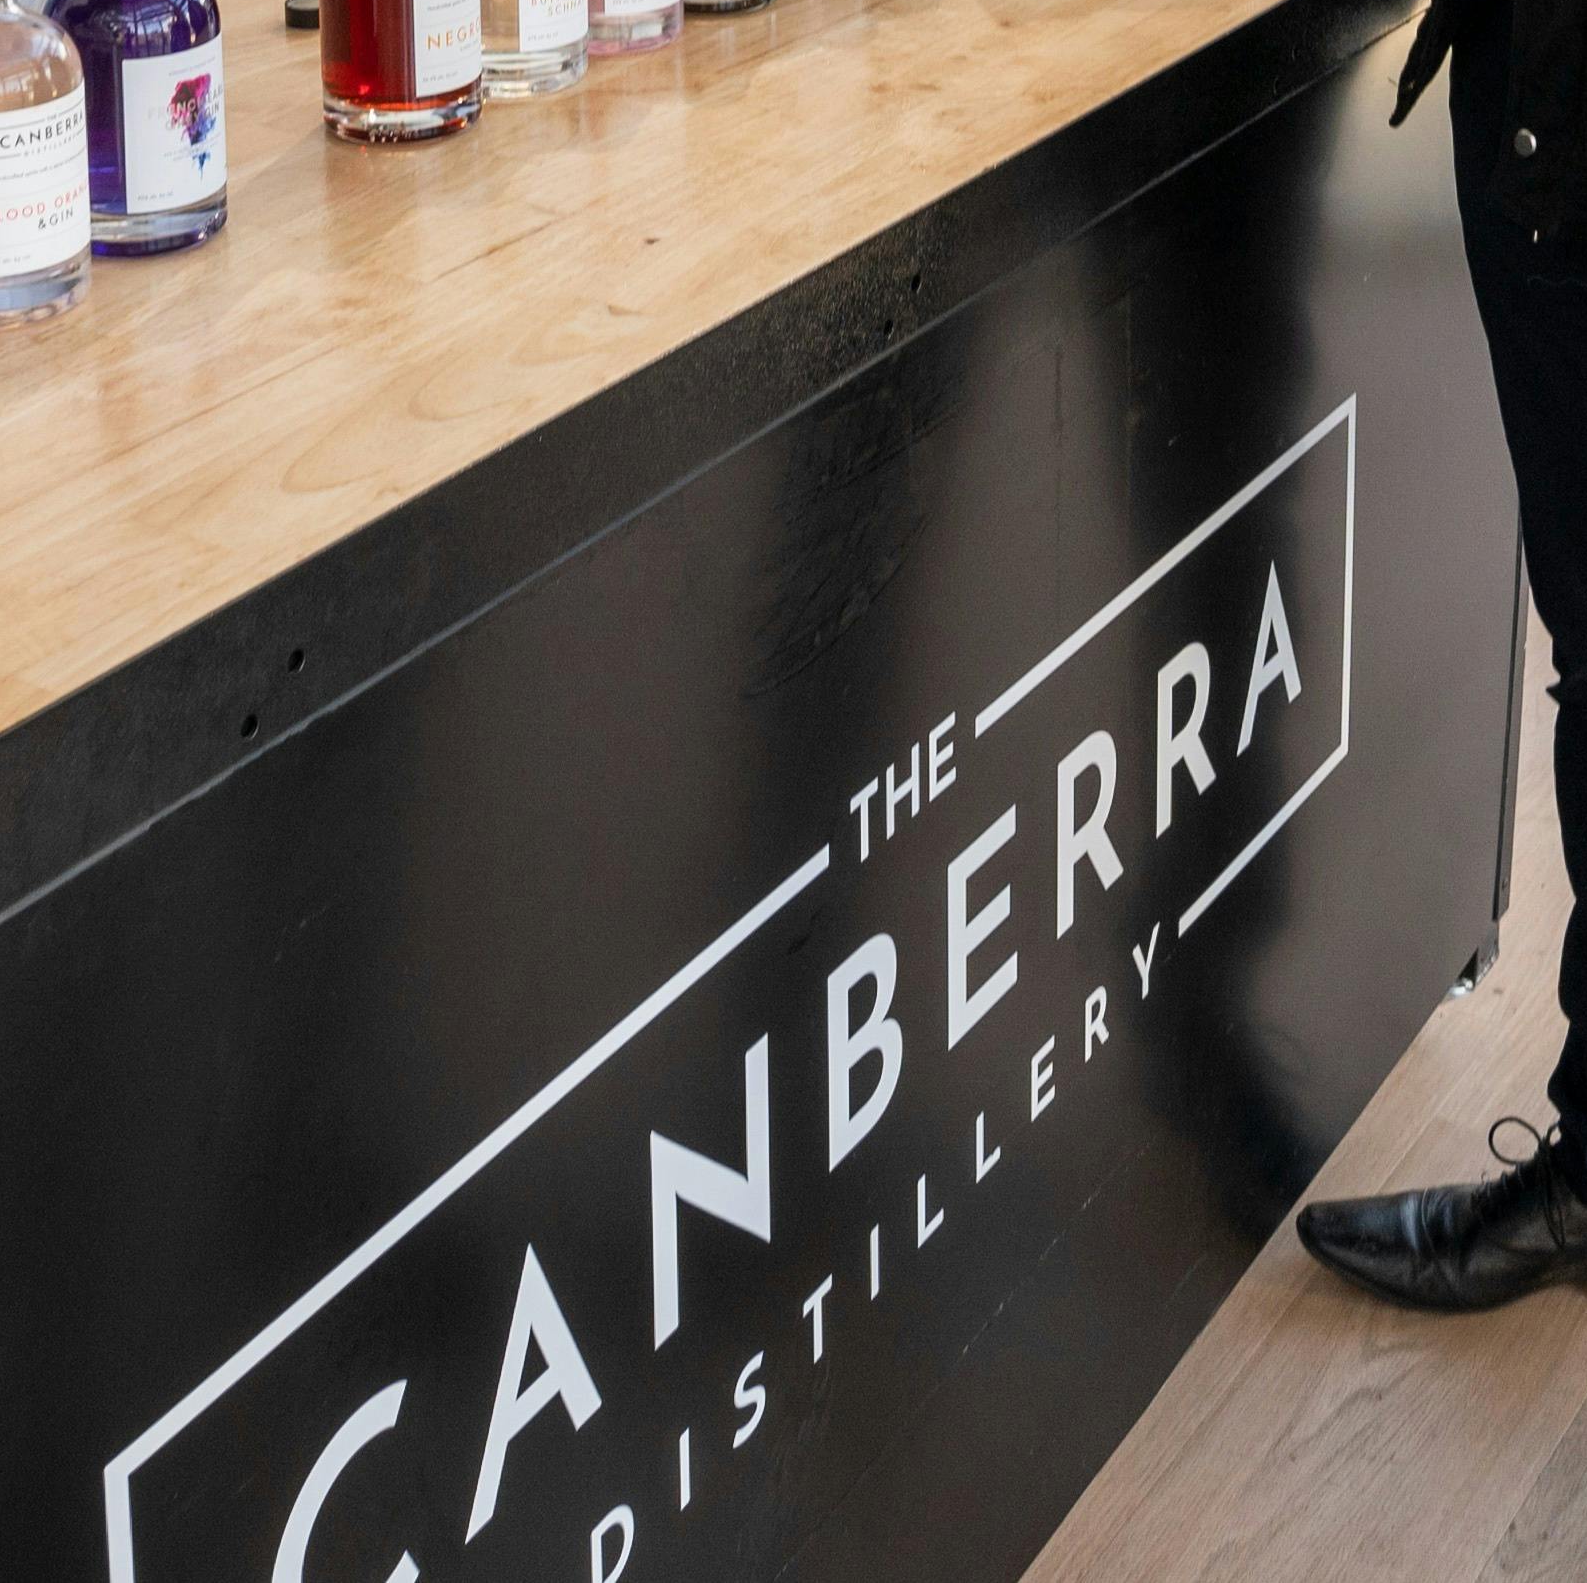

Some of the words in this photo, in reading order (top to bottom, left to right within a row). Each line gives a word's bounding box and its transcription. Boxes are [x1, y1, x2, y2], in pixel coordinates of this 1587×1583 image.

[271, 559, 1303, 1583] CANBERRA
[850, 713, 958, 862] THE
[591, 922, 1160, 1583] DISTILLERY
